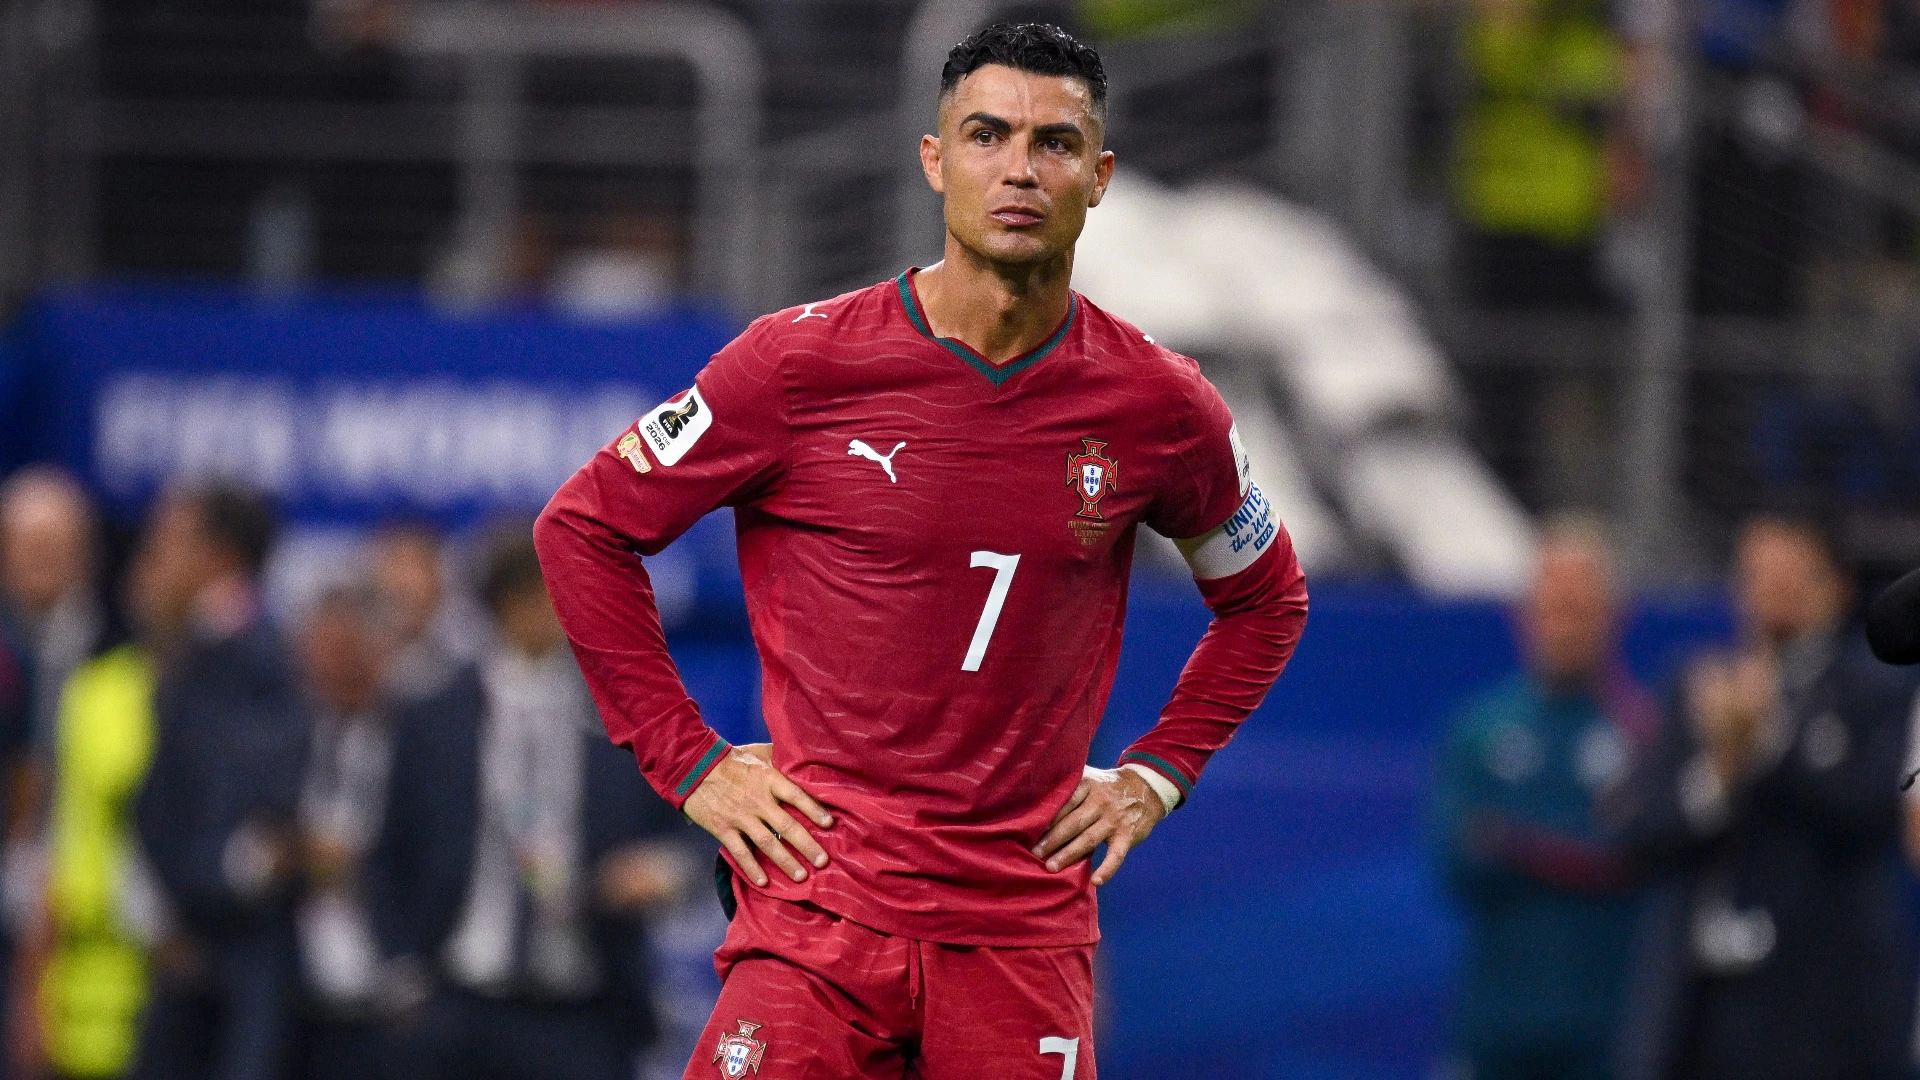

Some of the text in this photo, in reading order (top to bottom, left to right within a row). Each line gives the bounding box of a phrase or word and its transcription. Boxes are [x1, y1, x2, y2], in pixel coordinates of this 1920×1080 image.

[646, 424, 666, 451] 2026
[651, 420, 665, 437] WORLD
[662, 418, 673, 433] FIFA
[1223, 481, 1262, 537] UNITES
[1229, 532, 1254, 552] the
[1254, 523, 1274, 550] FIFA
[961, 550, 1021, 672] 7
[1039, 1036, 1080, 1080] 7
